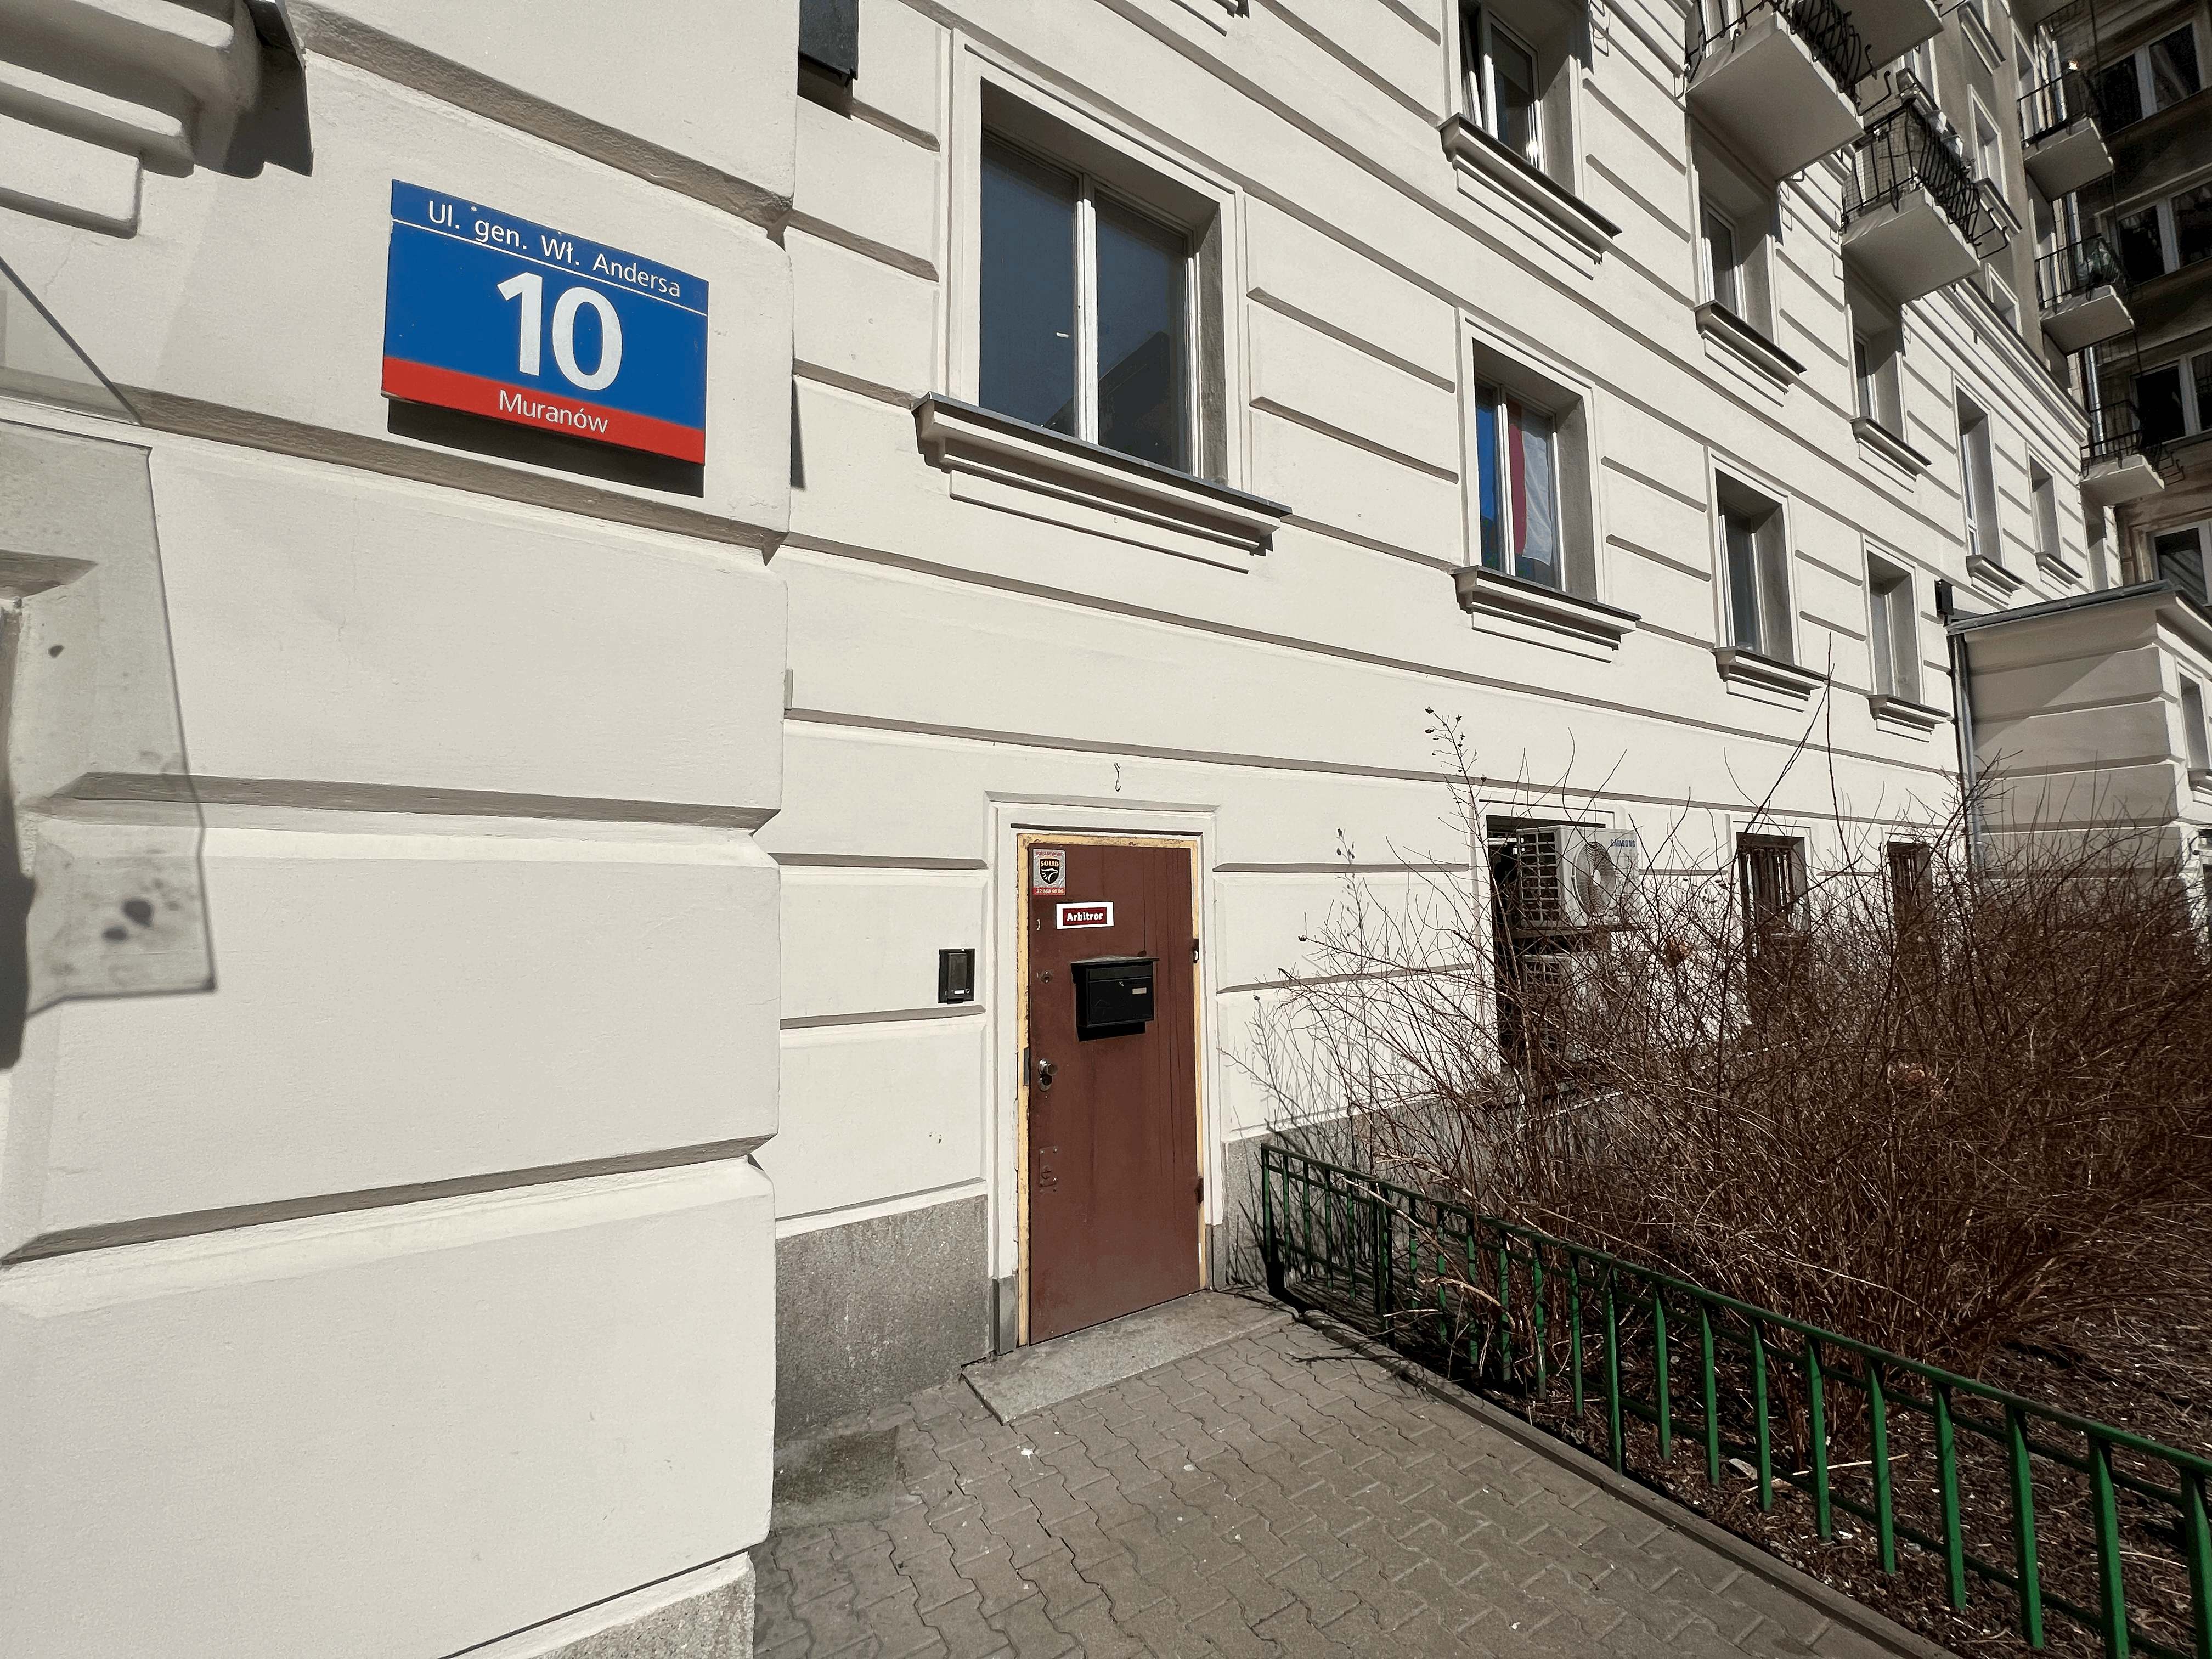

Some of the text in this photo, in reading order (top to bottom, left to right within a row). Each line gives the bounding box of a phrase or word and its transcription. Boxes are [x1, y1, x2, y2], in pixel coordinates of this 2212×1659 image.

[429, 200, 680, 298] Ul. gen. Wł. Andersa
[497, 272, 623, 391] 10
[499, 390, 608, 433] Muranów
[1066, 911, 1104, 922] Arbitror
